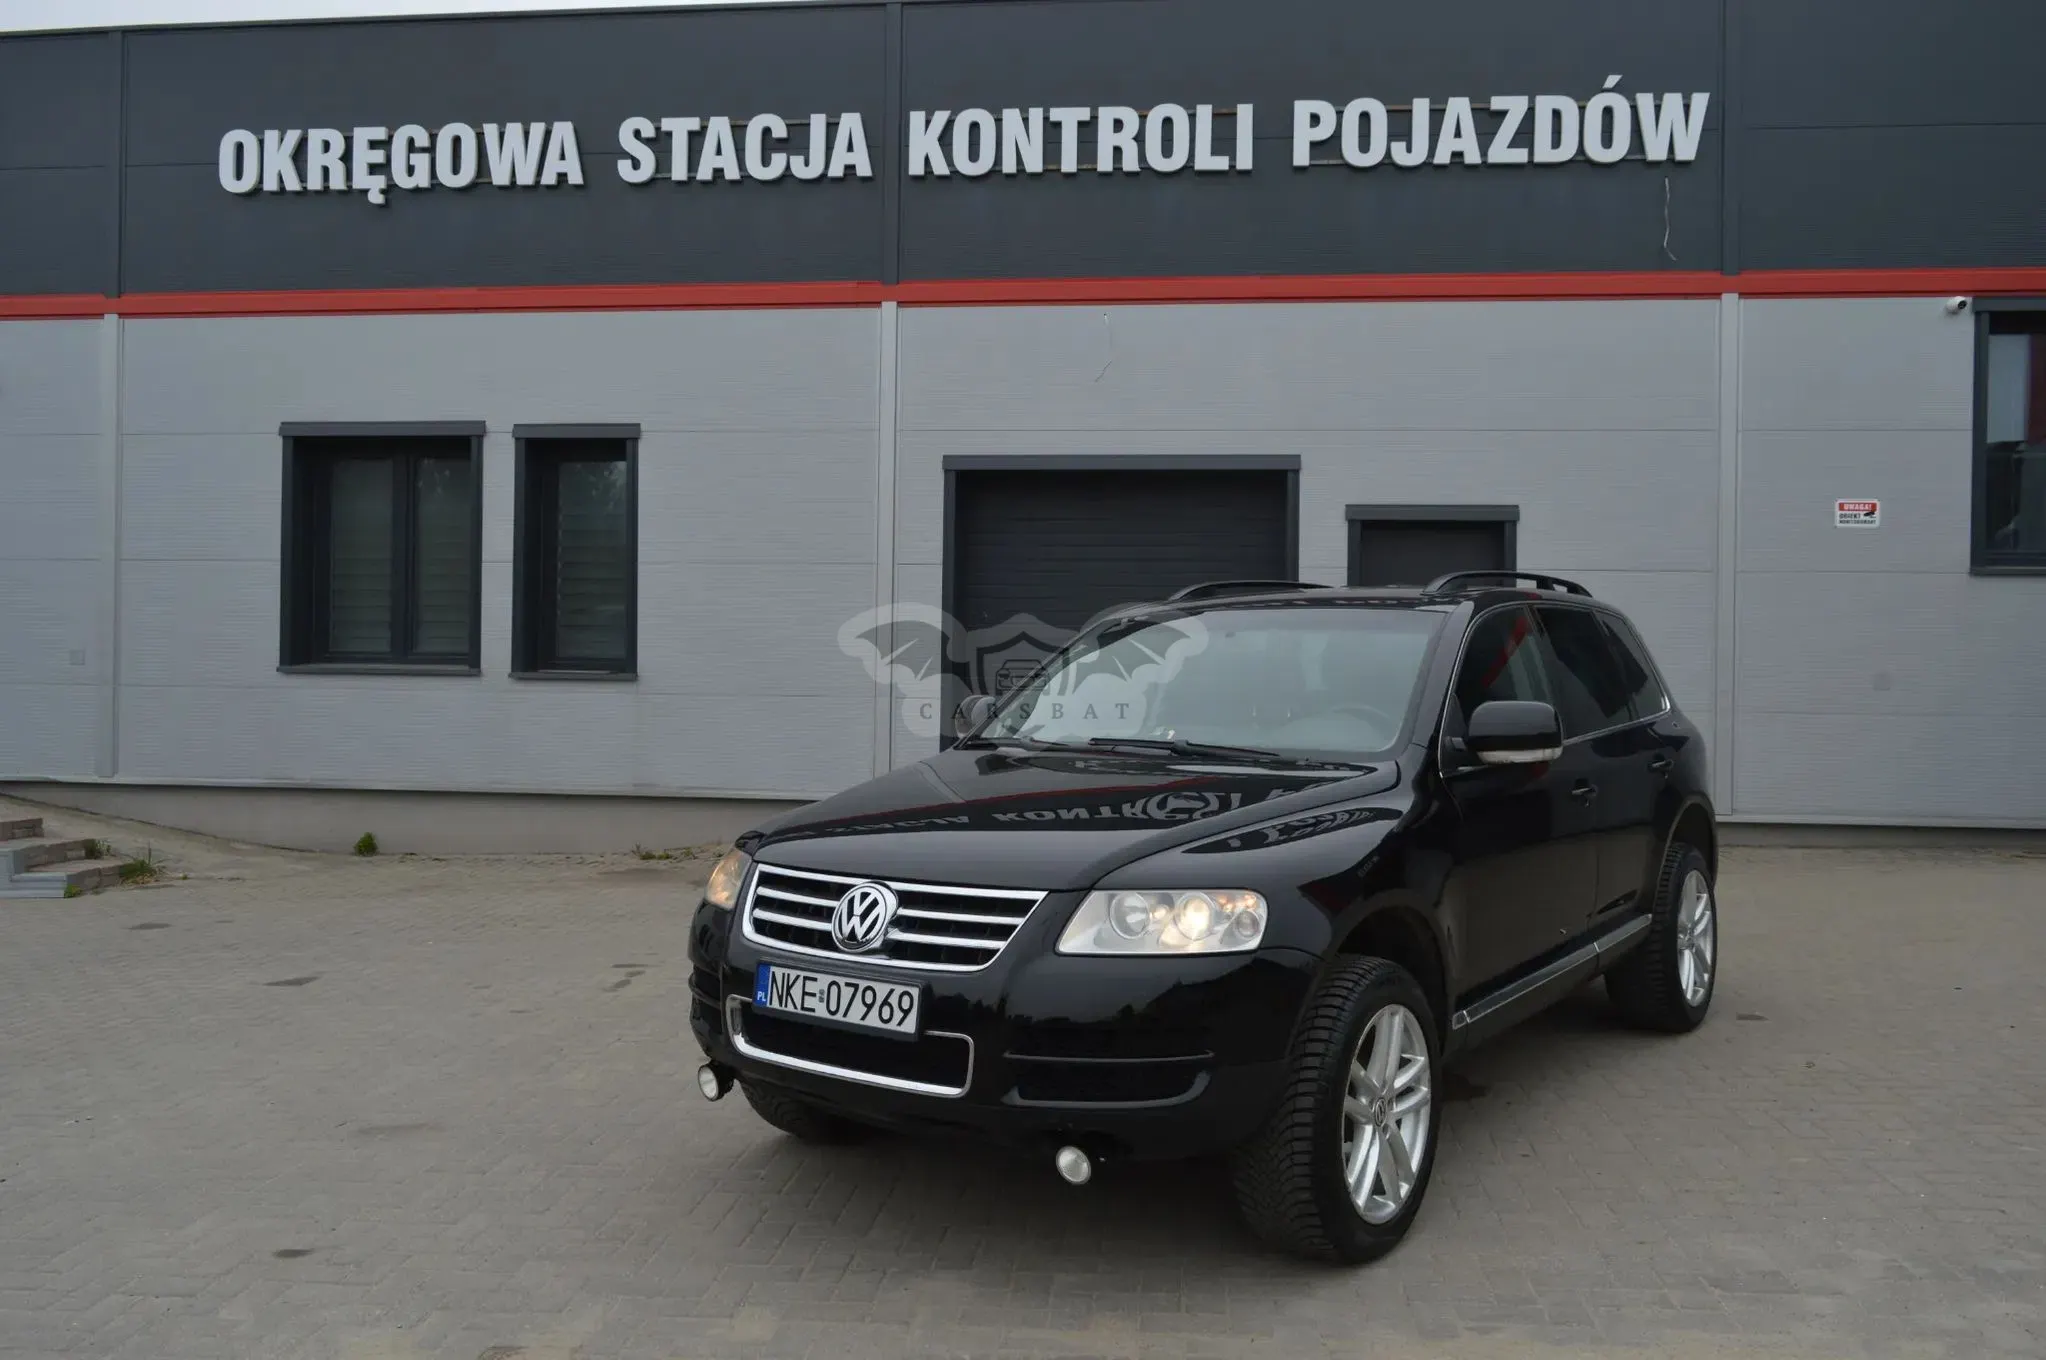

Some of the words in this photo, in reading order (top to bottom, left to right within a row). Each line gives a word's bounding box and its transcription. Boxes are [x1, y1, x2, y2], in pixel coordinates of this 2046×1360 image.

[219, 121, 584, 204] OKRĘGOWA
[617, 112, 872, 183] STACJA
[908, 103, 1253, 176] KONTROLI
[1293, 74, 1710, 168] POJAZDÓW
[757, 991, 767, 1002] PL
[768, 970, 818, 1013] NKE
[825, 980, 914, 1027] 07969
